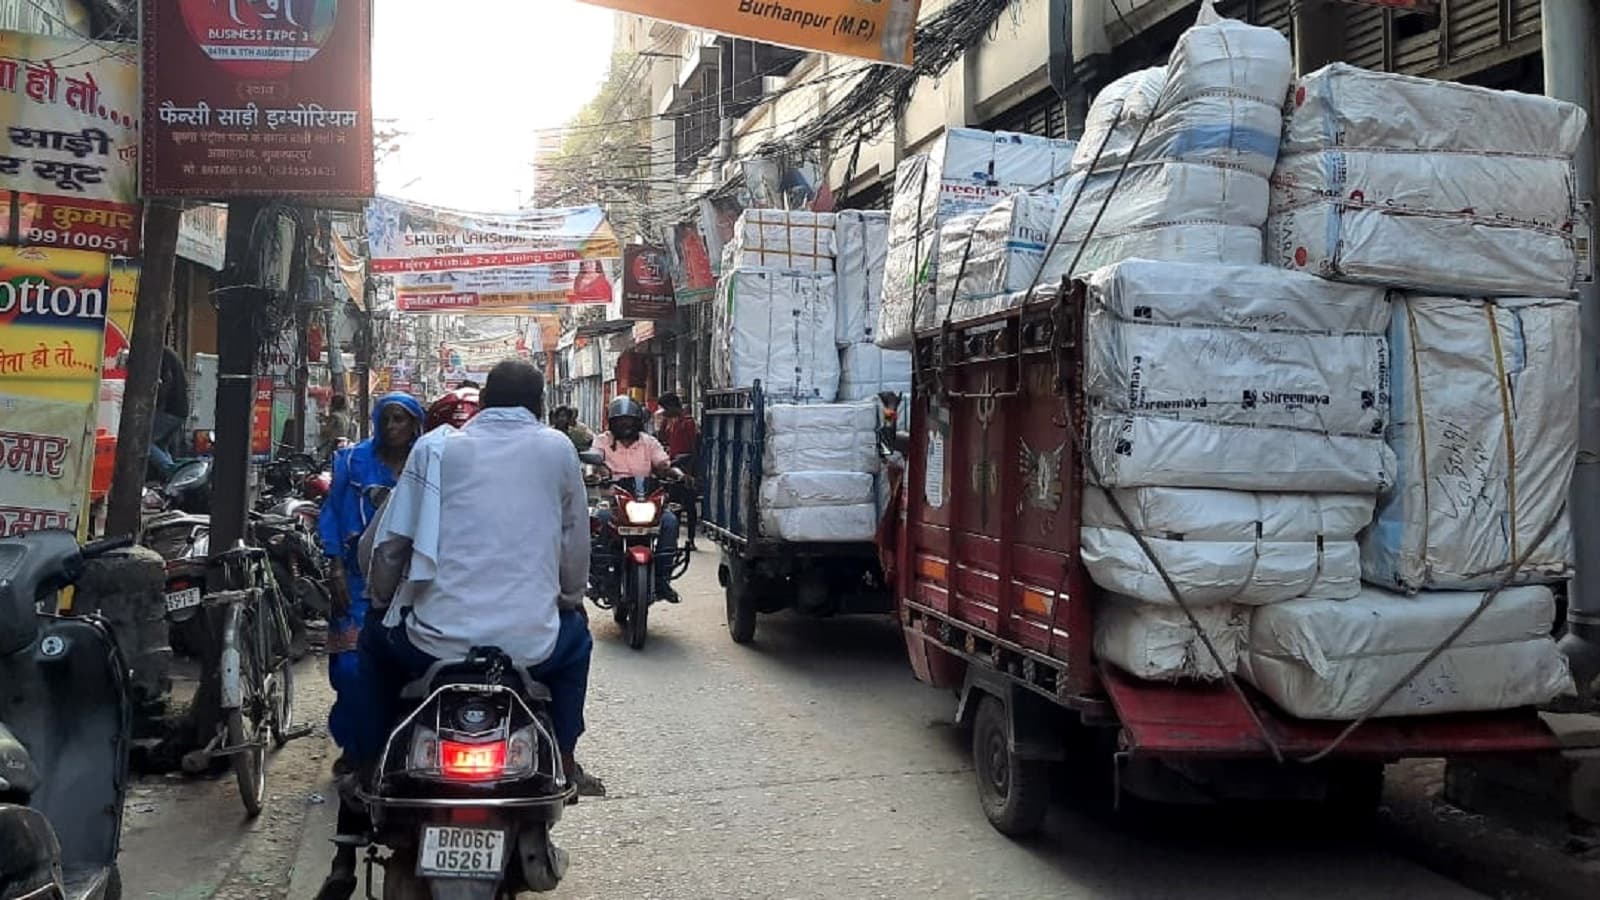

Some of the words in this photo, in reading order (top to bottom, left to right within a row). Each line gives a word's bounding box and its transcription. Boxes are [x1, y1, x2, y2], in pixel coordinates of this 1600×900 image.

[738, 0, 832, 29] Burhanpur
[832, 14, 876, 41] (M.P.)
[208, 29, 262, 40] BUSINESS
[256, 49, 290, 57] AUGUST
[25, 59, 59, 104] हो
[159, 100, 210, 127] फैन्सी
[216, 102, 259, 130] साड़ी
[265, 103, 358, 129] इम्पोरियम
[32, 159, 108, 192] सूट
[53, 205, 135, 230] कुमार
[404, 233, 456, 246] SHUBH
[505, 252, 542, 264] Lining
[544, 250, 576, 261] Cloth
[32, 342, 50, 370] हो
[1262, 390, 1330, 406] Shreemaya
[0, 430, 69, 476] मार
[438, 828, 496, 850] BR06C
